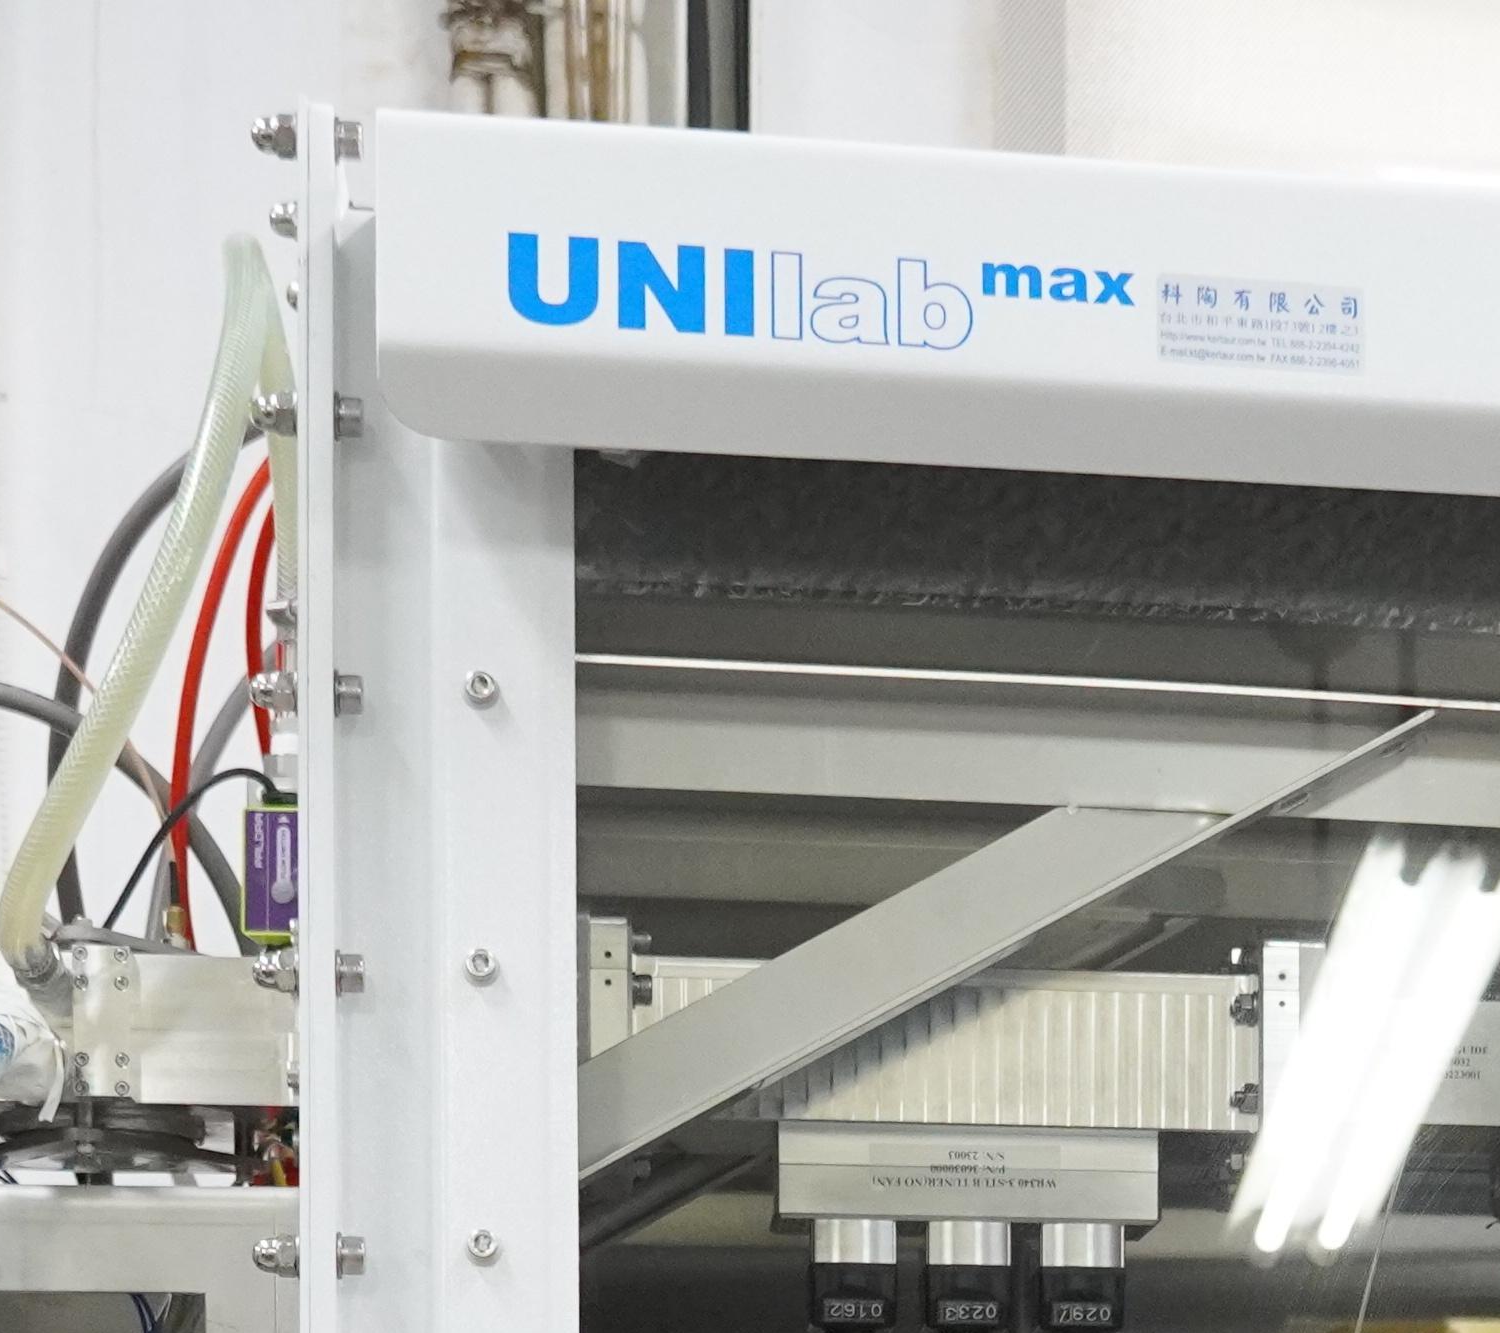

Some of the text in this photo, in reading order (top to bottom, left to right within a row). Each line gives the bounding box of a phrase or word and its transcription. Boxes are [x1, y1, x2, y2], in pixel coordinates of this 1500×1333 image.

[981, 260, 1137, 308] max
[1161, 282, 1359, 320] 科陶有限公司
